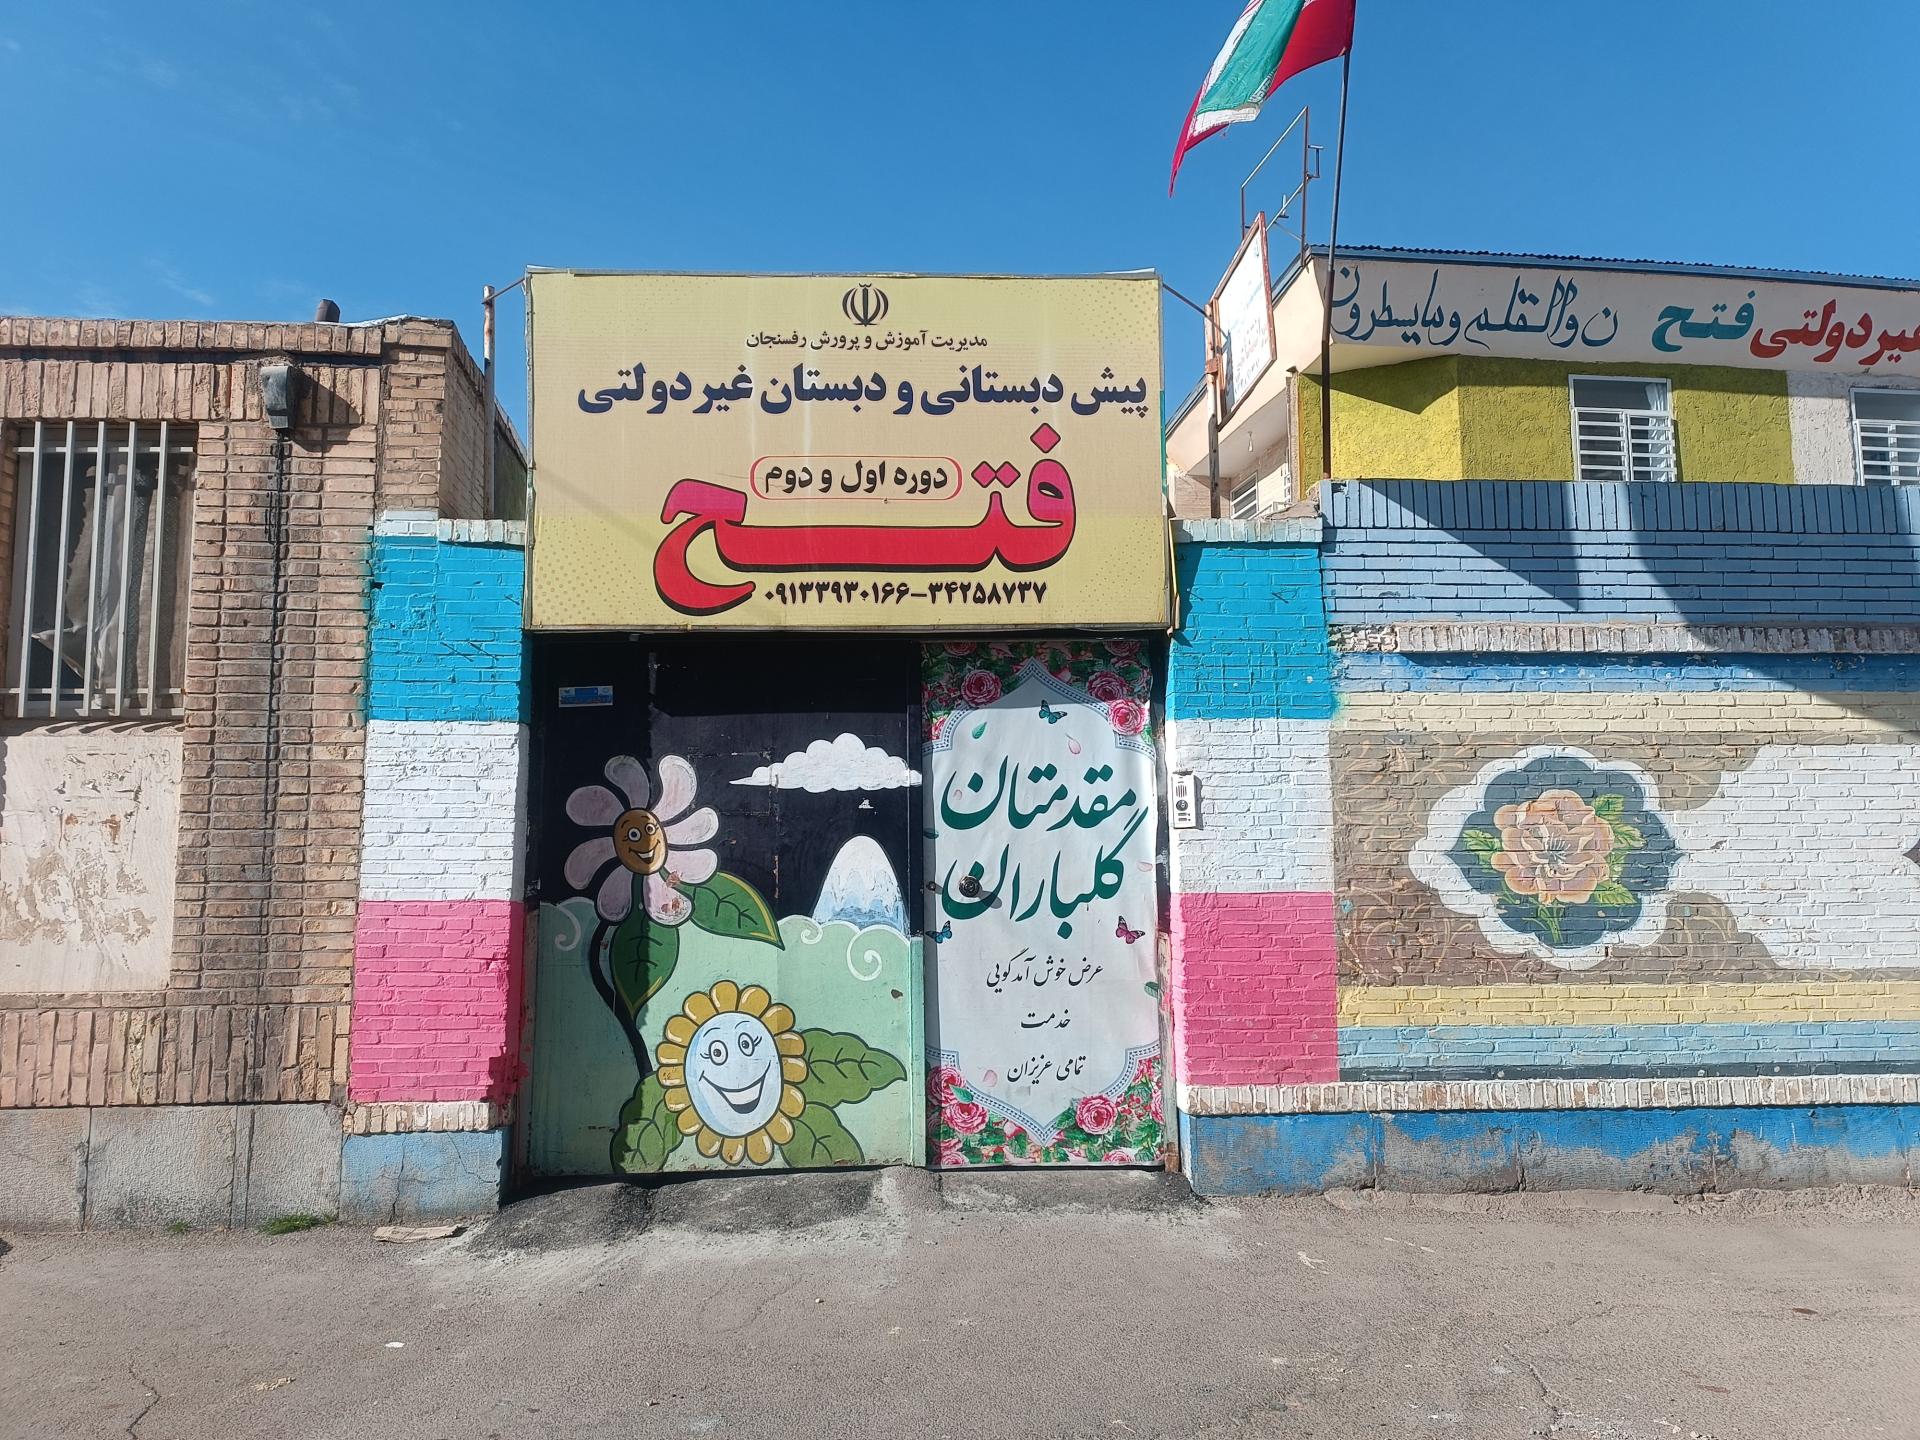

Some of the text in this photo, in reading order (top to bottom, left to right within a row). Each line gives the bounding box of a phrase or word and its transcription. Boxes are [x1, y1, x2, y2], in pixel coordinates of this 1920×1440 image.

[746, 330, 988, 352] مدیریت آموزش و پرورش رفسنجان
[1581, 306, 1618, 347] ن
[1651, 290, 1756, 353] فتح
[761, 362, 887, 415] دبستان
[893, 380, 914, 415] و
[920, 364, 1064, 415] دبستانی
[1070, 366, 1149, 418] پیش
[765, 460, 948, 494] دوره اول و دوم
[652, 422, 1077, 617] فتح
[941, 755, 1137, 831] مقدمتان
[941, 806, 1149, 939] گلباران
[1034, 955, 1066, 987] خوش
[1068, 957, 1103, 987] عرض
[1021, 1009, 1071, 1029] خدمت
[1007, 1054, 1086, 1085] تمامی عزیزان
